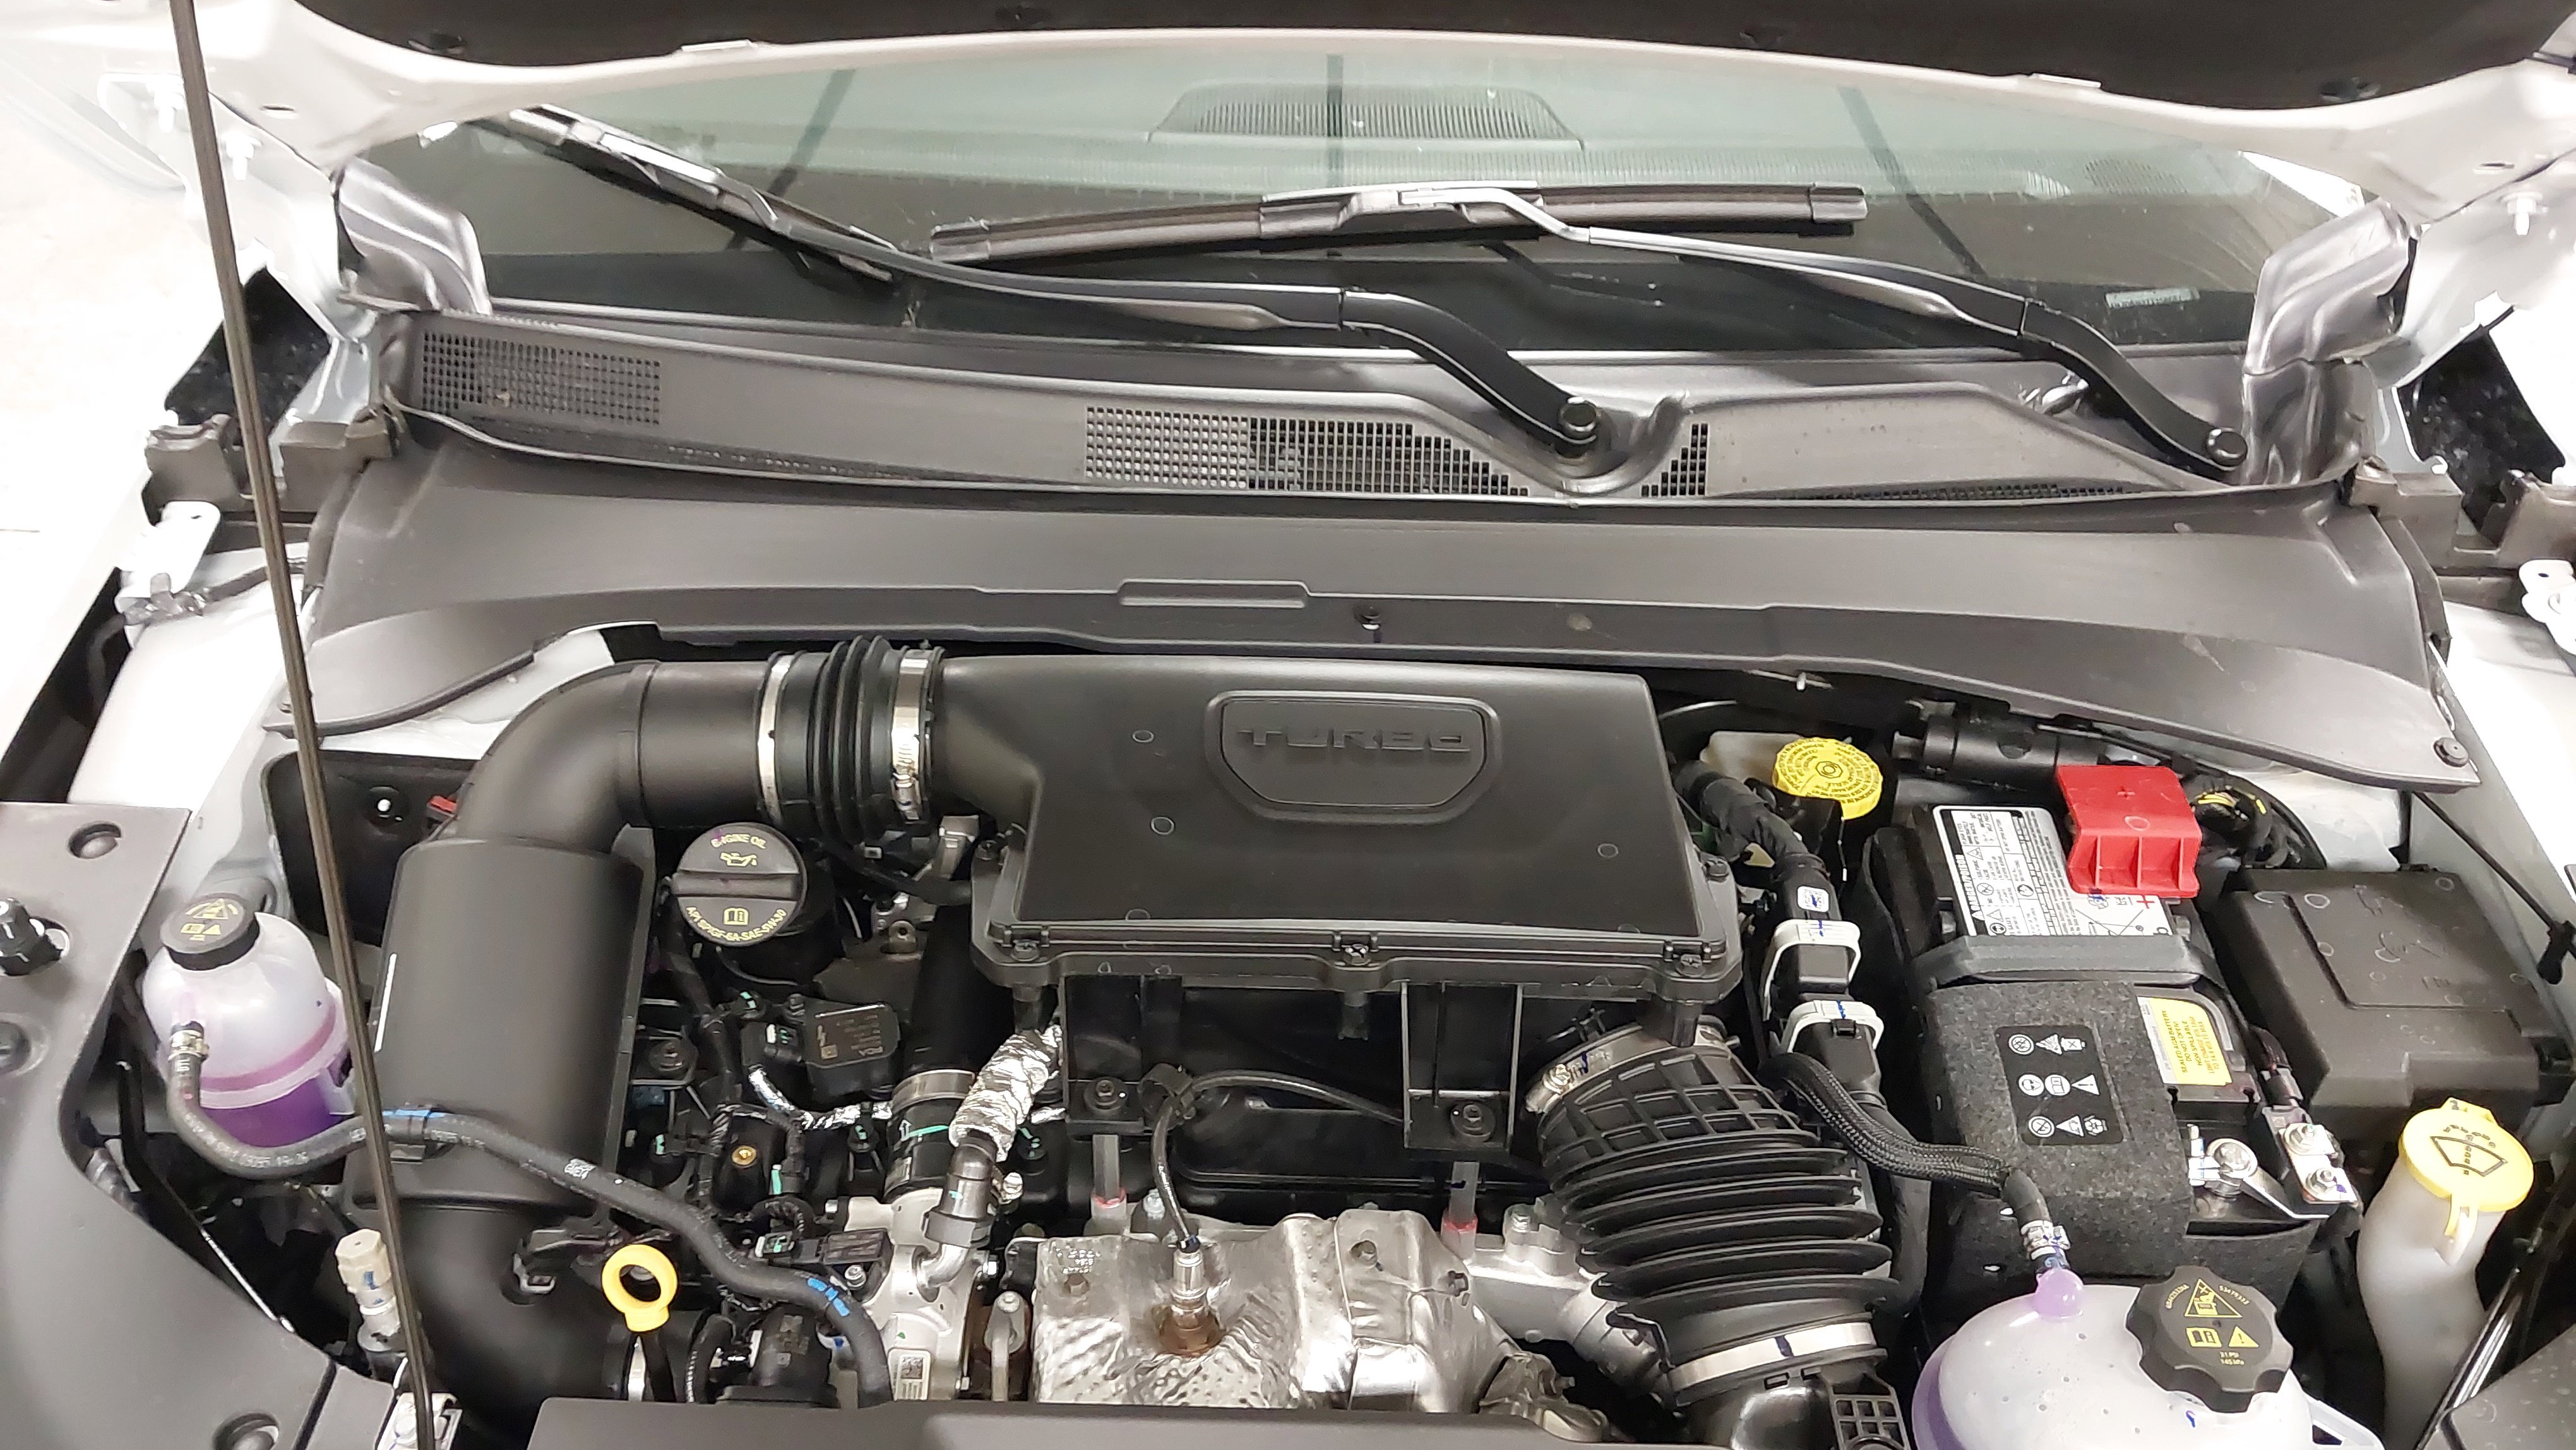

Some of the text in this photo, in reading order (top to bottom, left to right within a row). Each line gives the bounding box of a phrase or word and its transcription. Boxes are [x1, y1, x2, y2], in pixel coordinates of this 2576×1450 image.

[1236, 727, 1472, 753] TURBO
[710, 833, 768, 849] ENGINE OIL
[1954, 854, 1980, 911] DANGER/POISON
[2161, 1010, 2174, 1034] BATTERY
